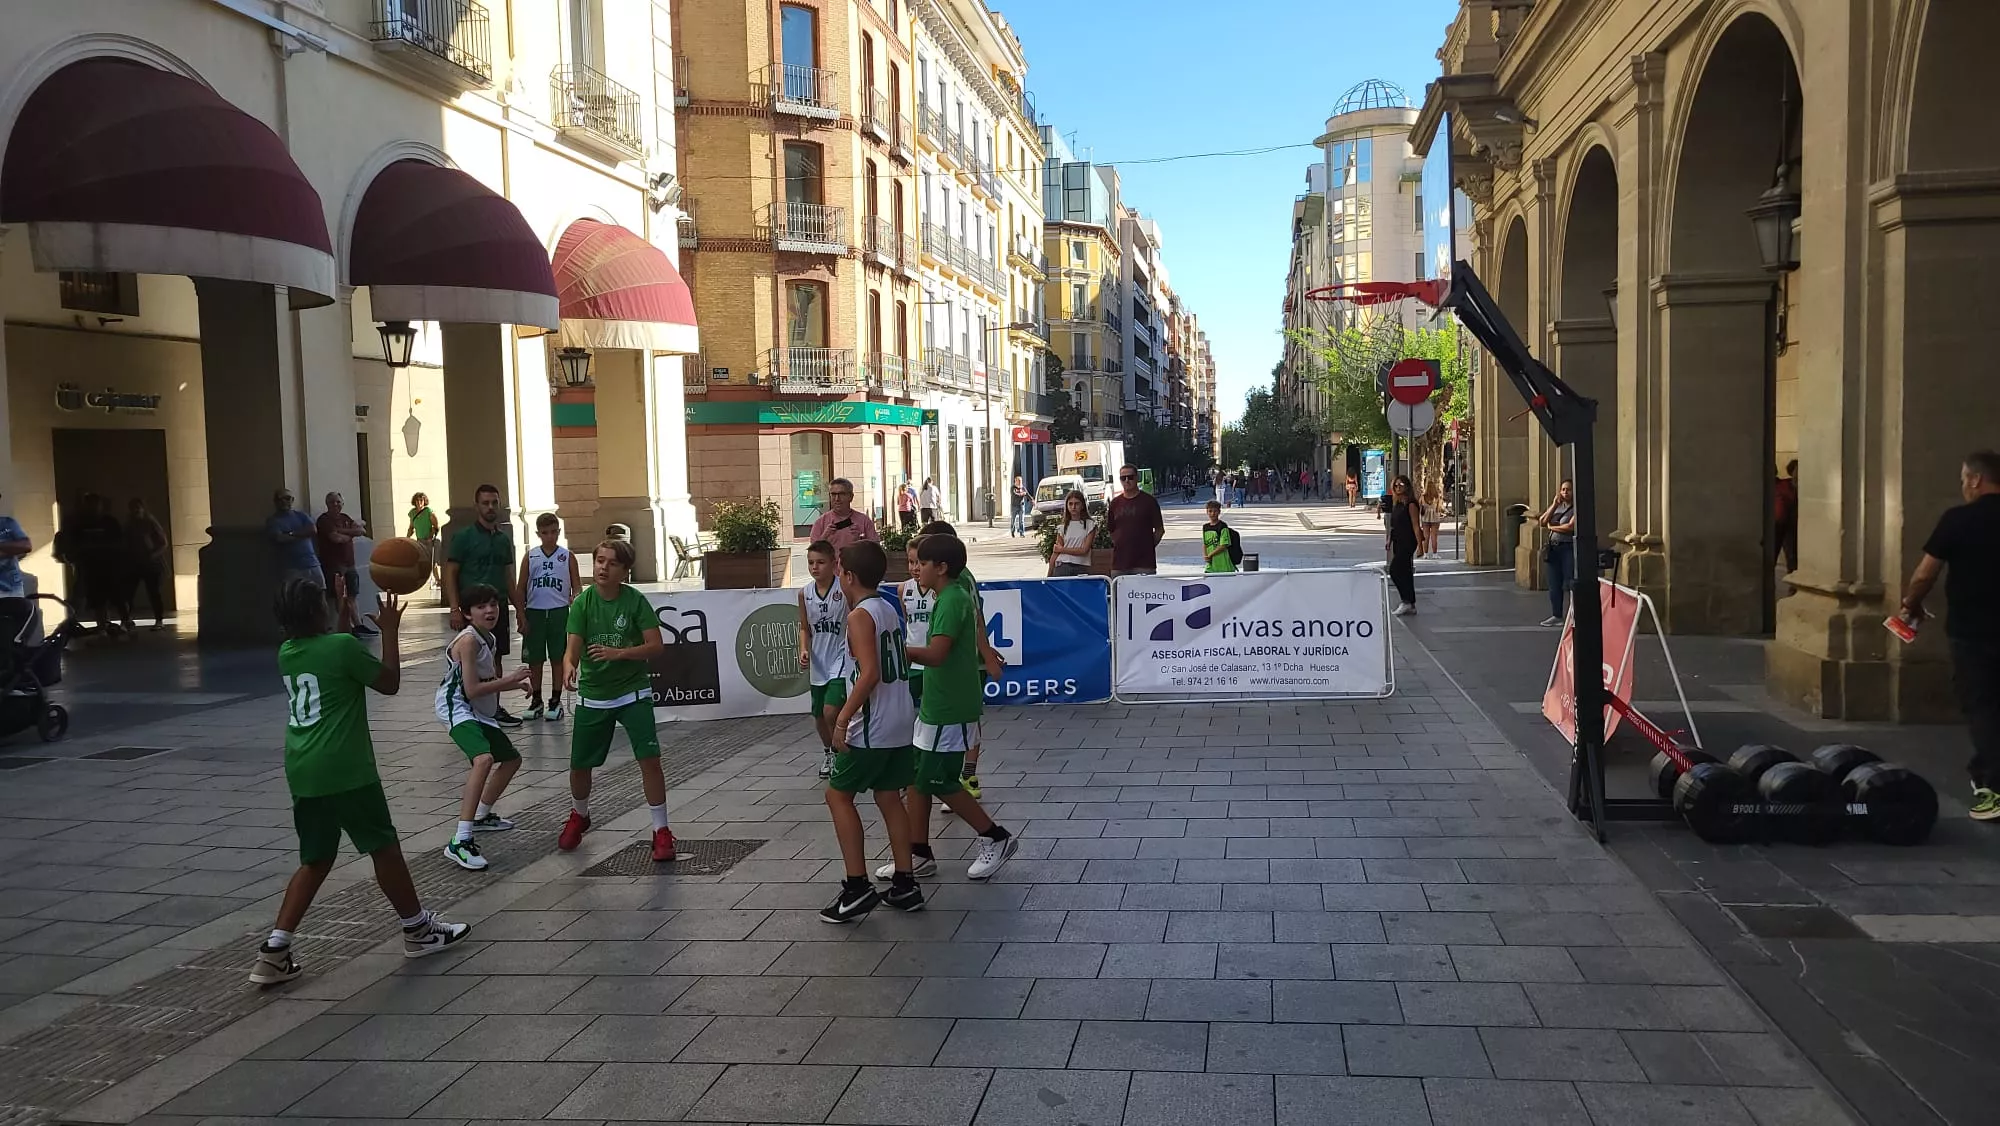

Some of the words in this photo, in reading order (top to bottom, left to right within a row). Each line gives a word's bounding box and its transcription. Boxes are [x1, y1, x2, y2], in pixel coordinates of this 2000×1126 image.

[686, 407, 697, 415] AL
[542, 561, 554, 571] 54
[1127, 589, 1176, 601] despacho
[916, 599, 928, 610] 16
[654, 605, 709, 646] sa
[1222, 616, 1284, 639] rivas
[1291, 618, 1374, 639] anoro
[880, 628, 909, 684] 60
[1151, 646, 1201, 659] ASESORÍA
[1203, 646, 1241, 659] FISCAL,
[1243, 646, 1291, 656] LABORAL
[1293, 646, 1301, 656] Y
[1302, 643, 1350, 656] JURÍDICA
[1160, 665, 1170, 674] C/
[1171, 665, 1187, 674] San
[1188, 663, 1207, 673] José
[1208, 663, 1219, 672] de
[1220, 663, 1260, 673] Calasanz,
[1261, 662, 1271, 672] 13
[1283, 662, 1304, 672] Dcha
[1309, 663, 1340, 673] Huesca
[984, 678, 1078, 698] ODERS
[1170, 677, 1186, 687] Tel.
[1187, 676, 1202, 686] 974
[1204, 676, 1214, 686] 21
[1216, 676, 1226, 686] 16
[1229, 675, 1238, 685] 16
[1249, 676, 1330, 686] www.rivasanoro.com
[282, 672, 322, 727] 10
[651, 690, 661, 702] o
[664, 686, 715, 702] Abarca
[1852, 802, 1869, 815] NBA
